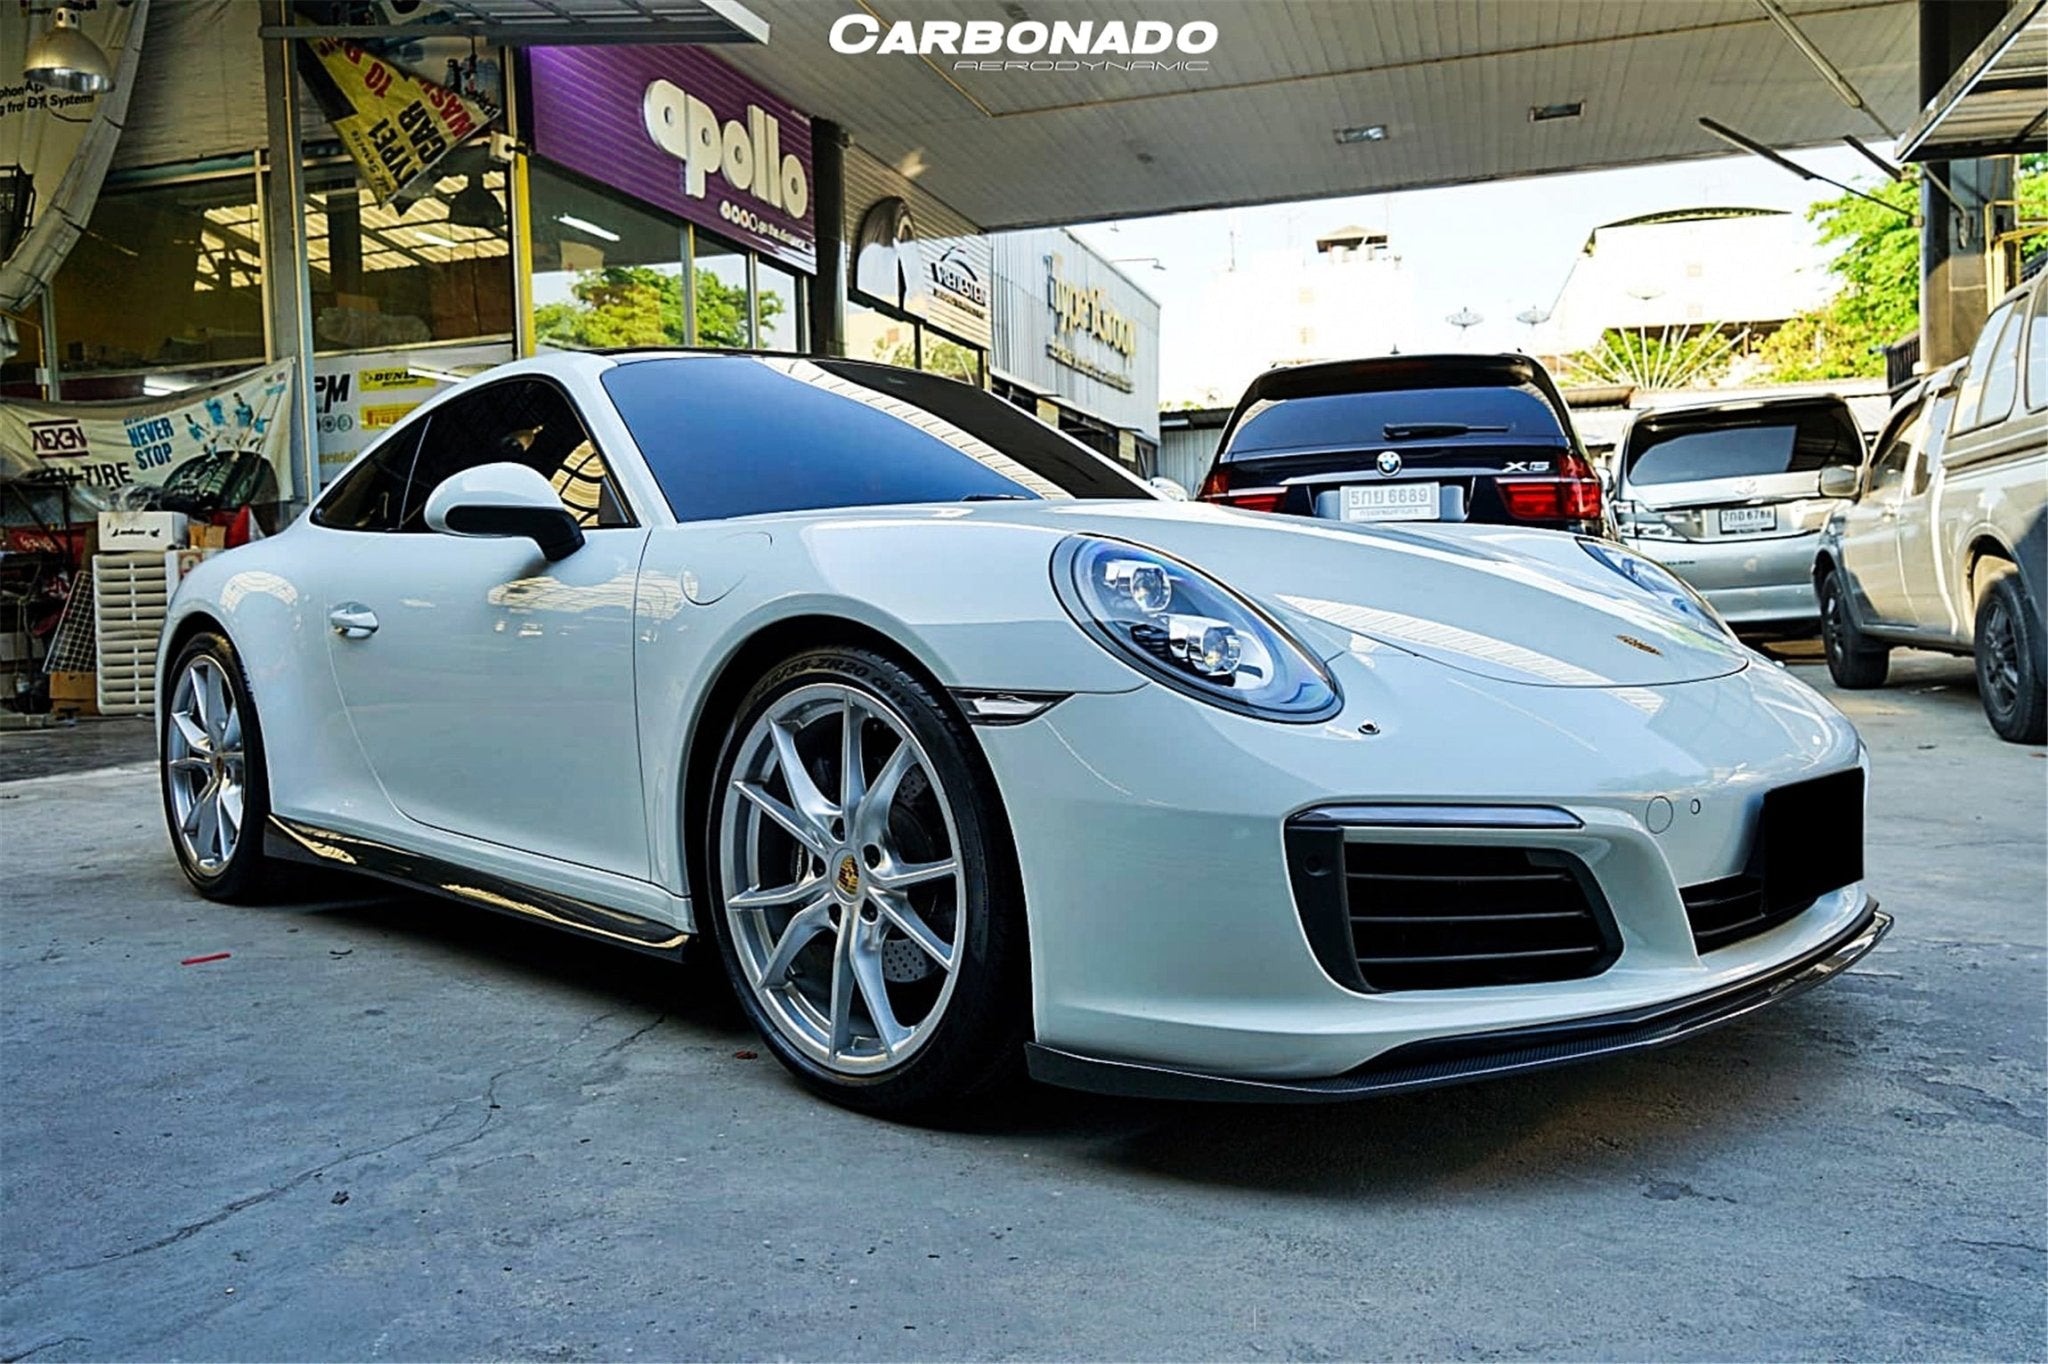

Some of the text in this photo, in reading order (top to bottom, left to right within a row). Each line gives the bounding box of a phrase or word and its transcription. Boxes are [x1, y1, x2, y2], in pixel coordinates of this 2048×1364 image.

[398, 100, 447, 165] CAR
[644, 79, 808, 220] apollo
[32, 426, 88, 451] NEXEN
[127, 417, 174, 448] NEVER
[135, 443, 173, 470] STOP
[81, 462, 134, 489] TIRE
